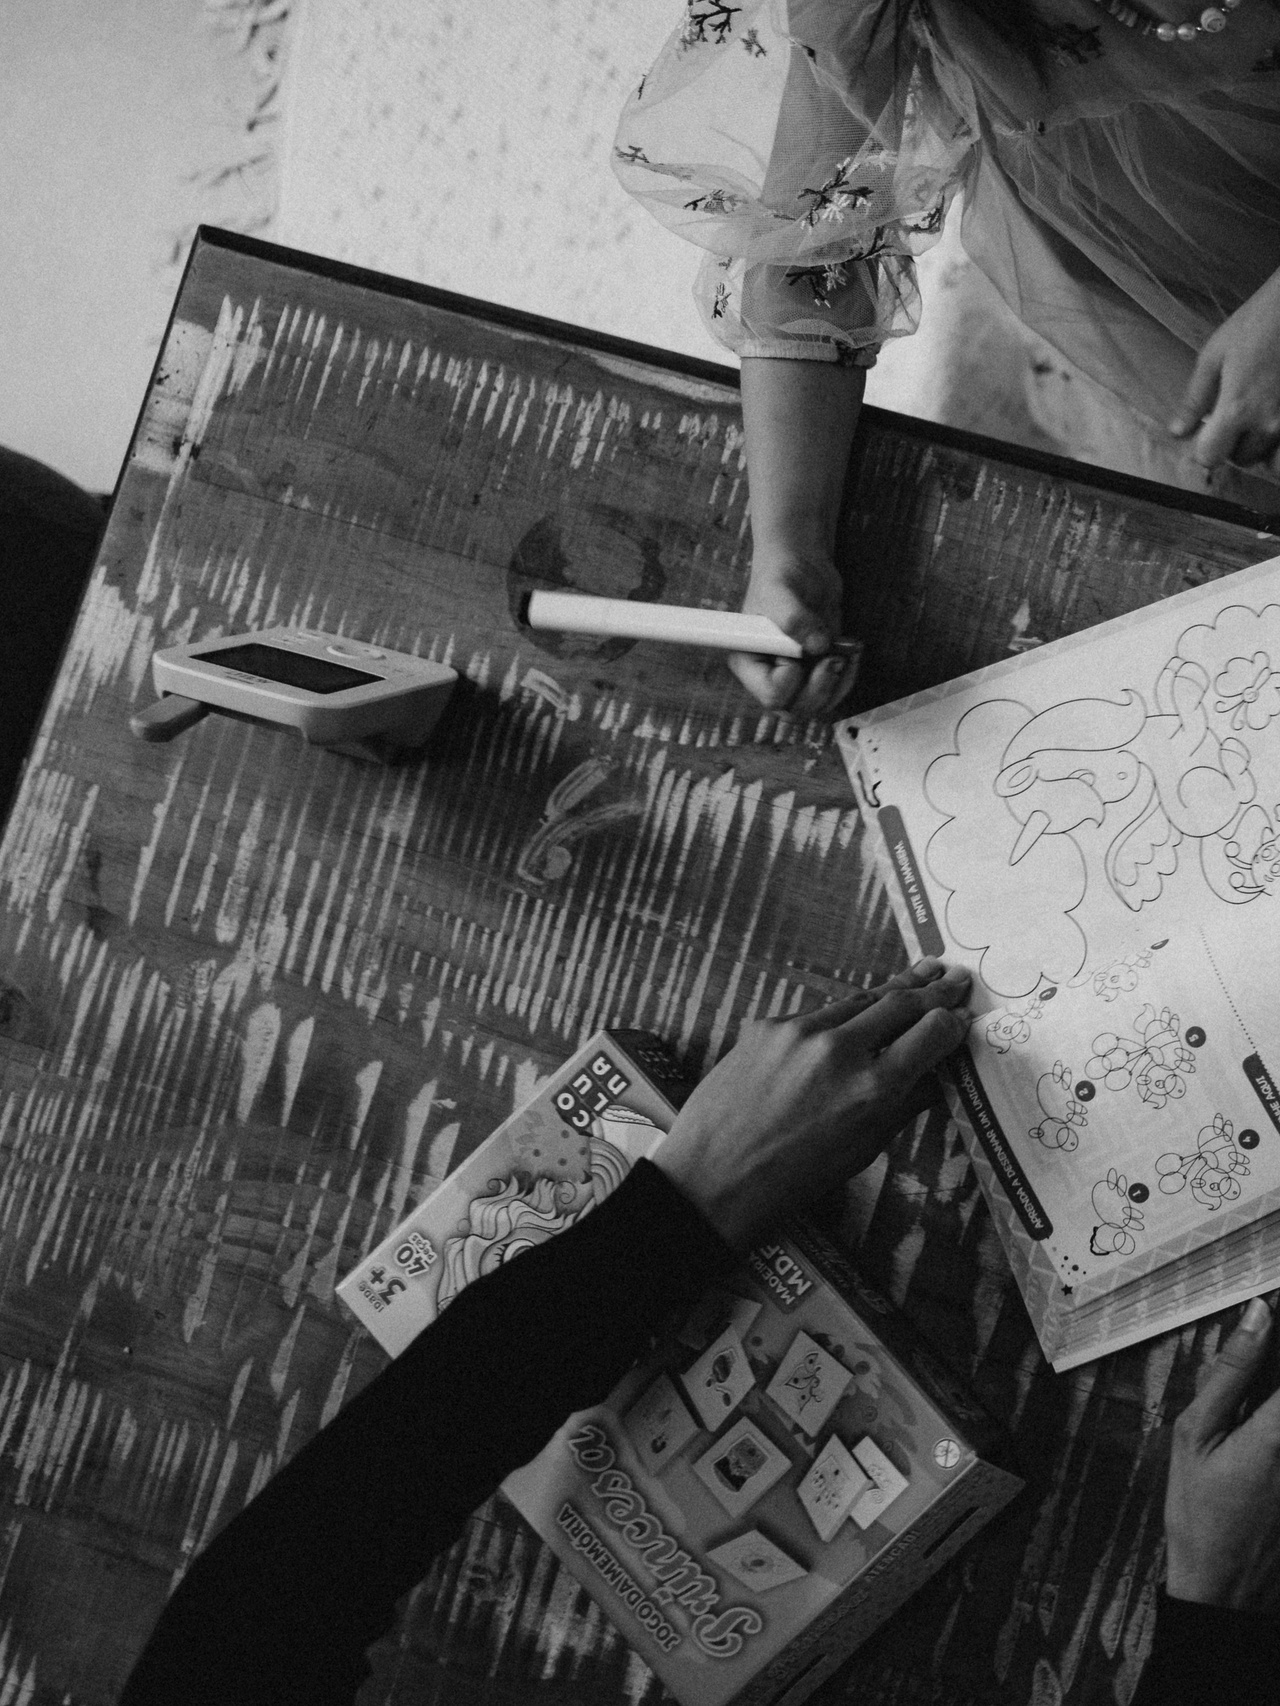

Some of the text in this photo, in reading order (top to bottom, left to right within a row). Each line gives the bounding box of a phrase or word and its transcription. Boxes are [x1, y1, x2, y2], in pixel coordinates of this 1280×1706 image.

[908, 884, 919, 894] A
[910, 893, 929, 925] PINTE
[1188, 1033, 1199, 1043] 5
[1078, 1086, 1089, 1098] 2
[1255, 1075, 1276, 1102] AQUI
[557, 1092, 590, 1127] CO
[978, 1111, 991, 1129] UM
[986, 1127, 1016, 1179] DESENHAR
[1242, 1135, 1251, 1143] 4
[1011, 1176, 1021, 1187] A
[1132, 1188, 1141, 1197] 1
[1016, 1188, 1044, 1229] APRENDA
[397, 1245, 427, 1275] 40
[761, 1245, 813, 1296] M.D.F
[371, 1270, 407, 1306] 3+
[752, 1253, 796, 1305] MADEIRA
[568, 1424, 762, 1657] Princesa
[556, 1502, 681, 1651] JOGO DA MEMÓRIA
